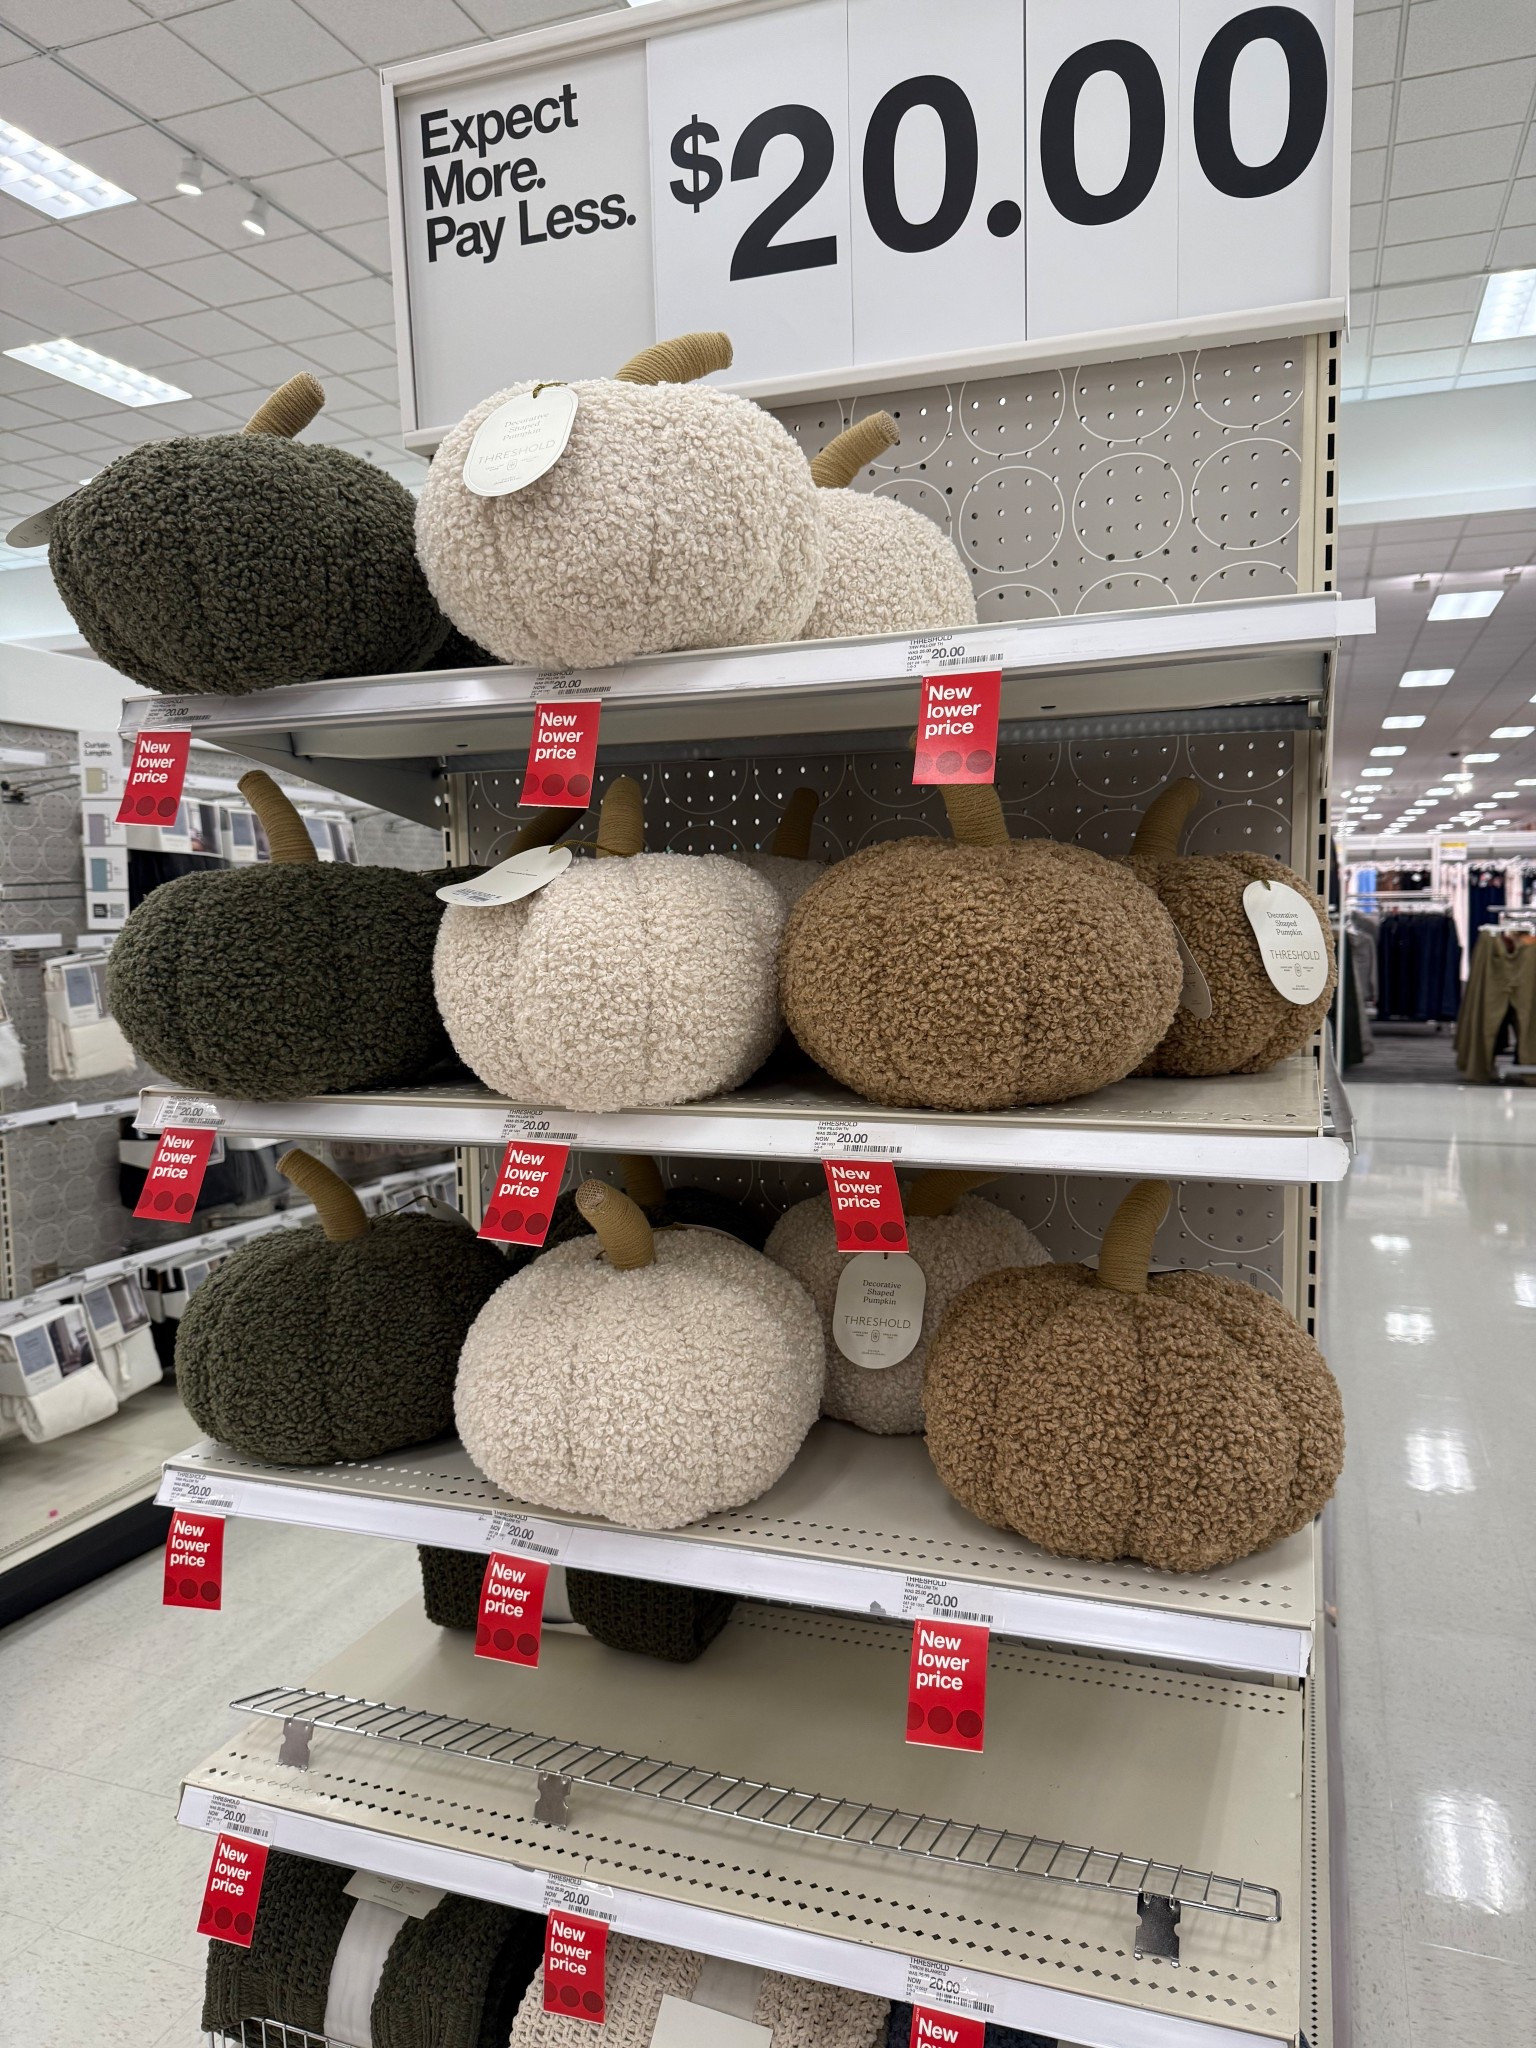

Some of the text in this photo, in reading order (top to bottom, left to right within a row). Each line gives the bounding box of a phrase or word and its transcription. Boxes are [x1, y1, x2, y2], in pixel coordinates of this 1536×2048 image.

[420, 83, 579, 159] Expect
[668, 4, 1328, 282] $20.00
[423, 157, 546, 211] More.
[426, 193, 637, 264] Pay Less.
[478, 439, 556, 465] THRESHOLD
[931, 646, 965, 659] 20.00
[553, 680, 581, 689] 20.00
[929, 685, 973, 701] New
[164, 708, 188, 716] 20.00
[927, 703, 981, 719] lower
[540, 712, 577, 727] New
[538, 729, 583, 743] lower
[925, 720, 974, 739] price
[140, 740, 171, 753] New
[535, 745, 576, 762] price
[137, 755, 175, 768] lower
[132, 770, 168, 785] price
[1266, 911, 1299, 919] Decorative
[1275, 920, 1298, 929] Shaped
[1276, 928, 1303, 936] Pumpkin
[1269, 949, 1320, 961] THRESHOLD
[180, 1107, 203, 1116] 20.00
[522, 1121, 550, 1130] 20.00
[163, 1135, 194, 1149] New
[837, 1133, 868, 1143] 20.00
[158, 1149, 196, 1164] lower
[509, 1150, 545, 1165] New
[152, 1165, 188, 1179] price
[505, 1165, 549, 1182] lower
[831, 1167, 870, 1179] New
[499, 1182, 539, 1197] price
[834, 1180, 882, 1194] lower
[837, 1195, 881, 1210] price
[862, 1279, 902, 1289] Decorative
[866, 1288, 895, 1297] Shaped
[863, 1296, 897, 1305] Pumpkin
[844, 1315, 911, 1329] THRESHOLD
[188, 1485, 211, 1496] 20.00
[174, 1520, 205, 1537] New
[508, 1525, 534, 1540] 20.00
[171, 1535, 210, 1553] lower
[170, 1552, 205, 1567] price
[491, 1561, 526, 1584] New
[487, 1579, 530, 1602] lower
[926, 1593, 958, 1608] 20.00
[485, 1599, 523, 1618] price
[920, 1629, 962, 1650] New
[918, 1649, 970, 1671] lower
[916, 1671, 963, 1690] price
[224, 1810, 246, 1823] 20.00
[219, 1843, 248, 1864] New
[215, 1858, 251, 1881] lower
[548, 1873, 581, 1885] THRESHOLD
[211, 1878, 244, 1896] price
[563, 1890, 589, 1905] 20.00
[552, 1919, 585, 1942] New
[550, 1938, 591, 1961] lower
[550, 1957, 587, 1975] price
[908, 1976, 922, 1984] NOW
[929, 1977, 960, 1994] 20.00
[918, 2017, 960, 2044] New
